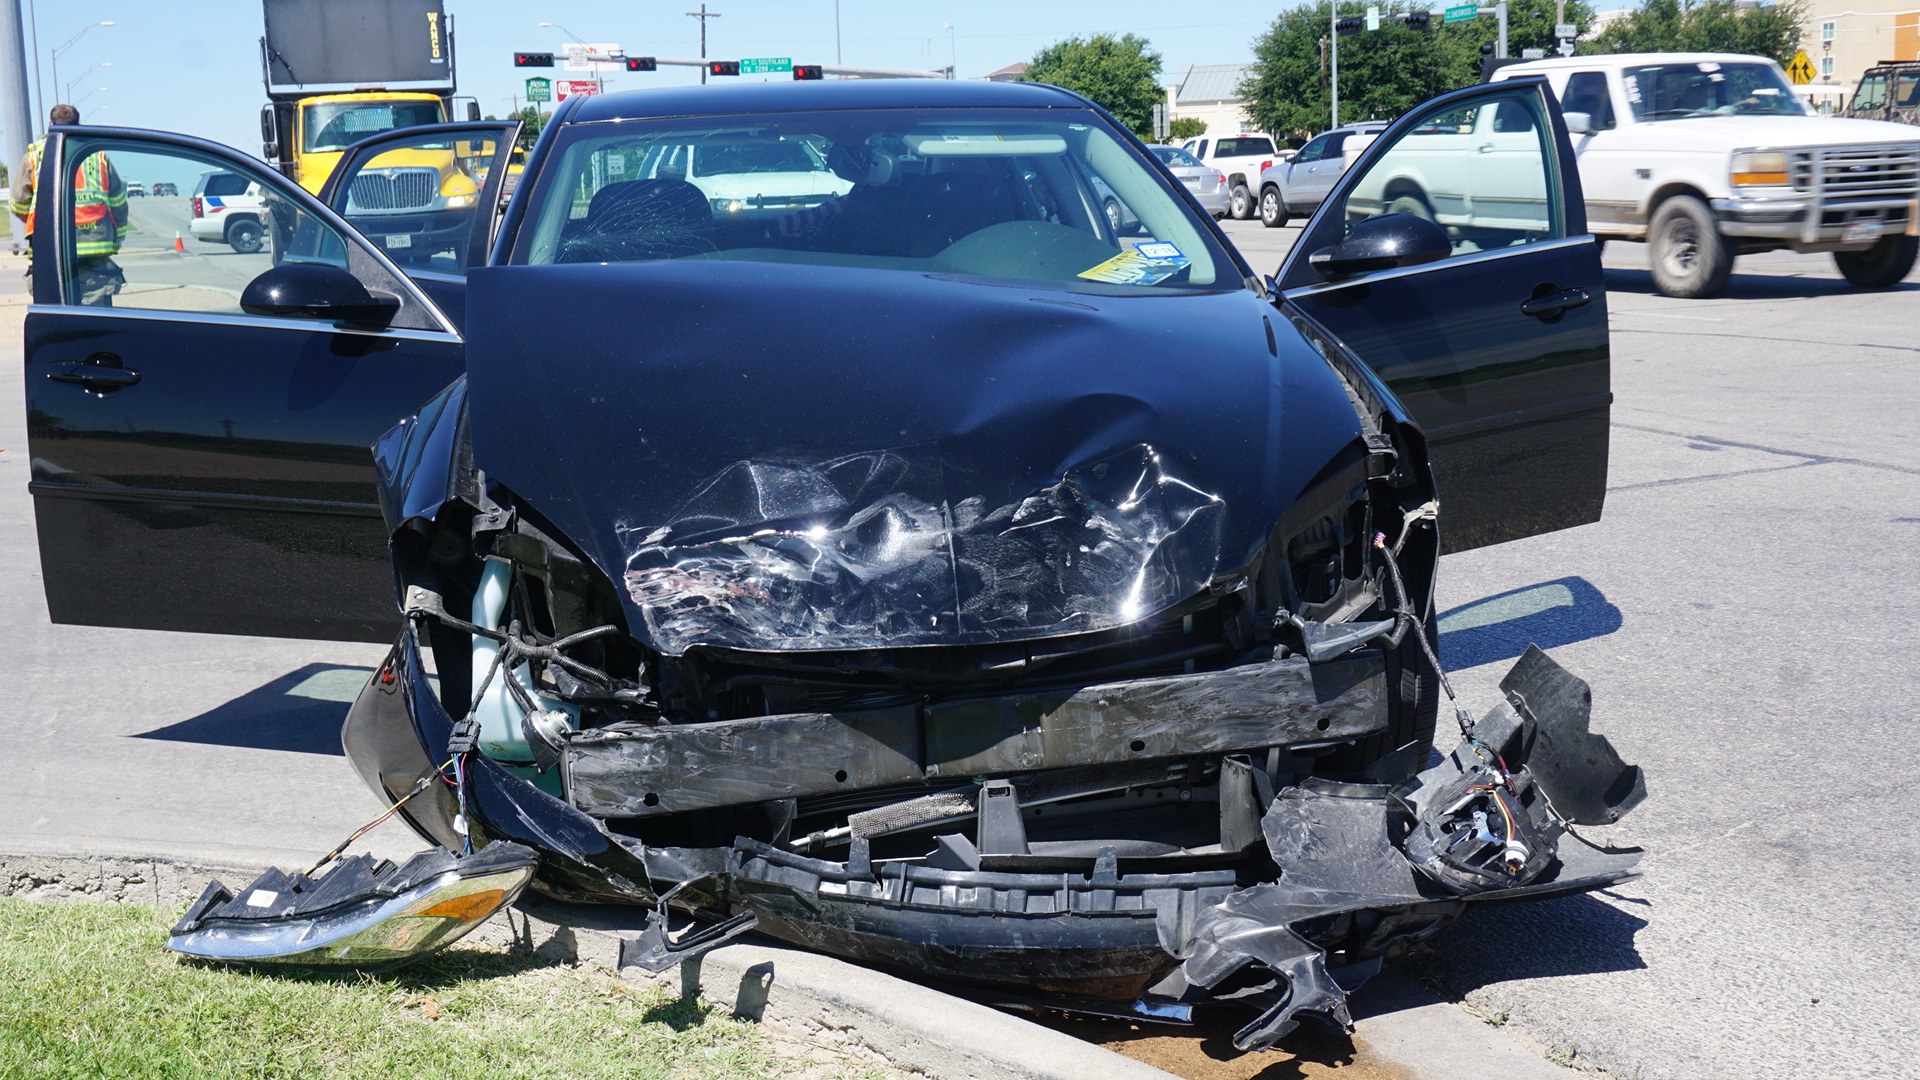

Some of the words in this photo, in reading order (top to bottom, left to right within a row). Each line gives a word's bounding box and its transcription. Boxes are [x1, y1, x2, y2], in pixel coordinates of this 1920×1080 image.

[1451, 7, 1472, 18] SHERWOOD
[427, 12, 440, 58] WANCO
[1556, 26, 1575, 34] NORTH
